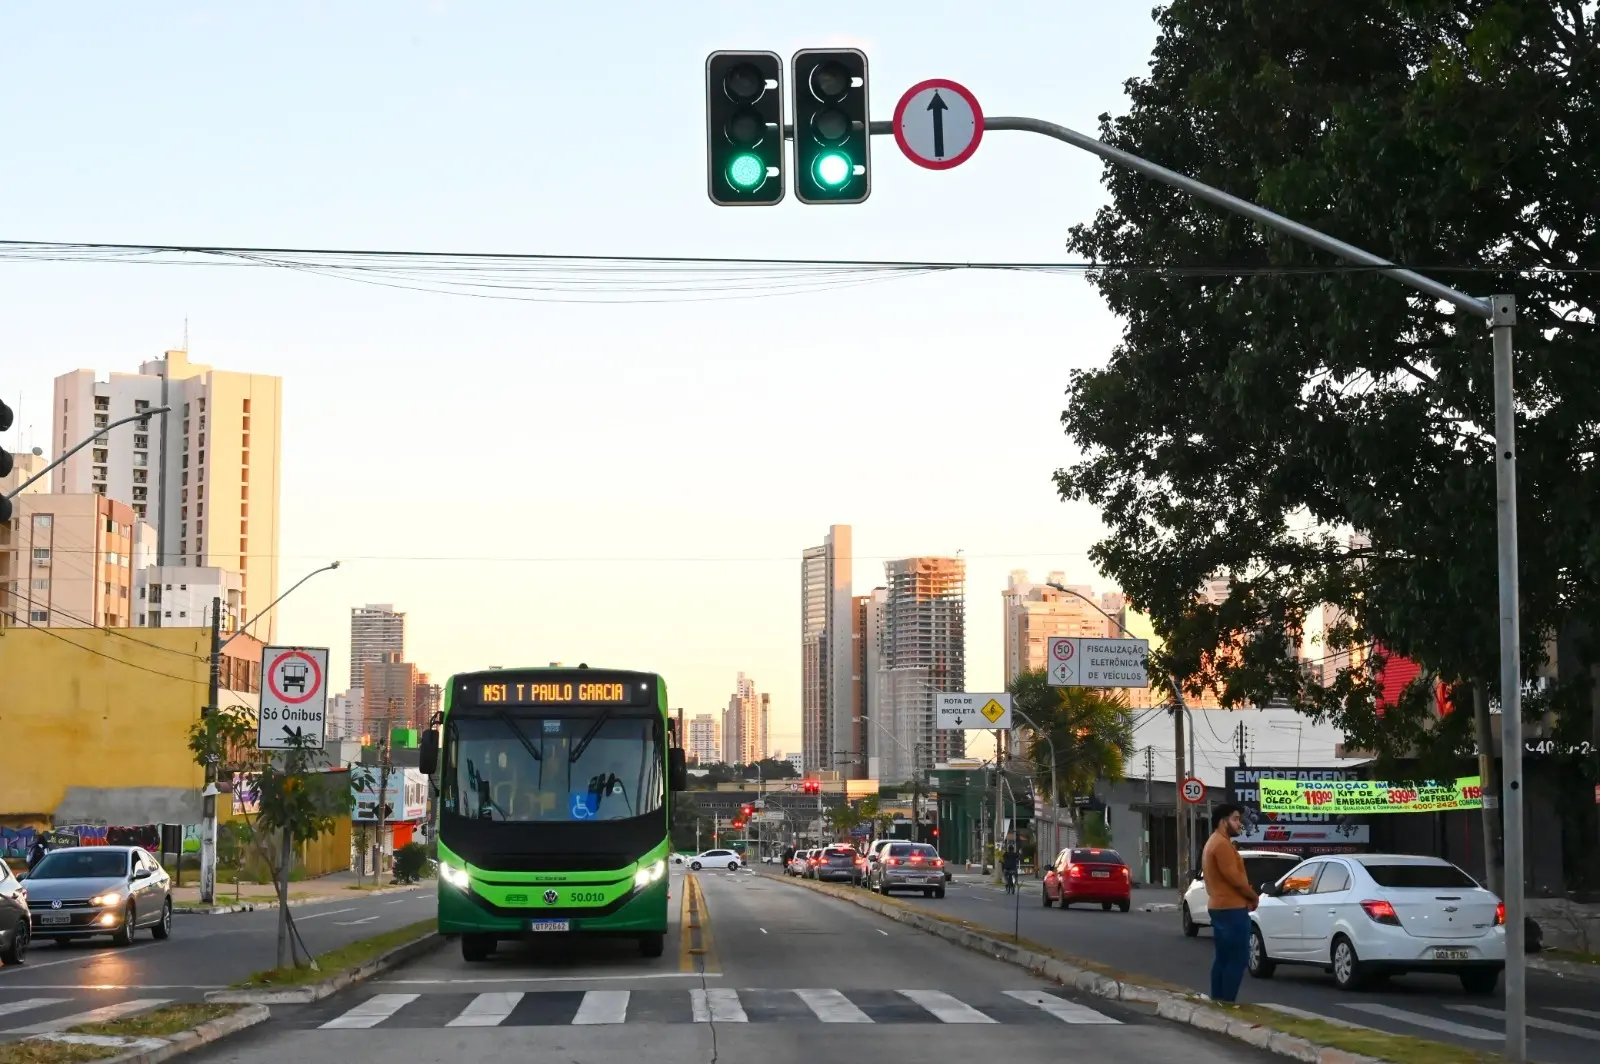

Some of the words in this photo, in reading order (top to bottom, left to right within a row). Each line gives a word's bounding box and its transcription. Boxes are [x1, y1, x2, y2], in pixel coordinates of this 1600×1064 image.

[1057, 645, 1070, 654] 50
[1086, 645, 1144, 655] FISCALIZAÇÃO
[1090, 658, 1139, 667] ELETRÔNICA
[1103, 671, 1142, 680] VEÍCULOS
[516, 684, 525, 701] T
[531, 684, 573, 701] PAULO
[578, 683, 623, 701] GARCIA
[263, 707, 278, 720] Só
[282, 705, 322, 721] Ônibus
[1185, 785, 1200, 795] 50
[1296, 782, 1369, 790] PROMOÇÃO
[1262, 787, 1289, 796] TROCA
[1337, 789, 1355, 797] KIT
[1335, 797, 1388, 806] EMBREAGEM
[1431, 794, 1454, 802] FREIO
[1412, 800, 1458, 810] 4000-2425
[570, 892, 605, 902] 50.010
